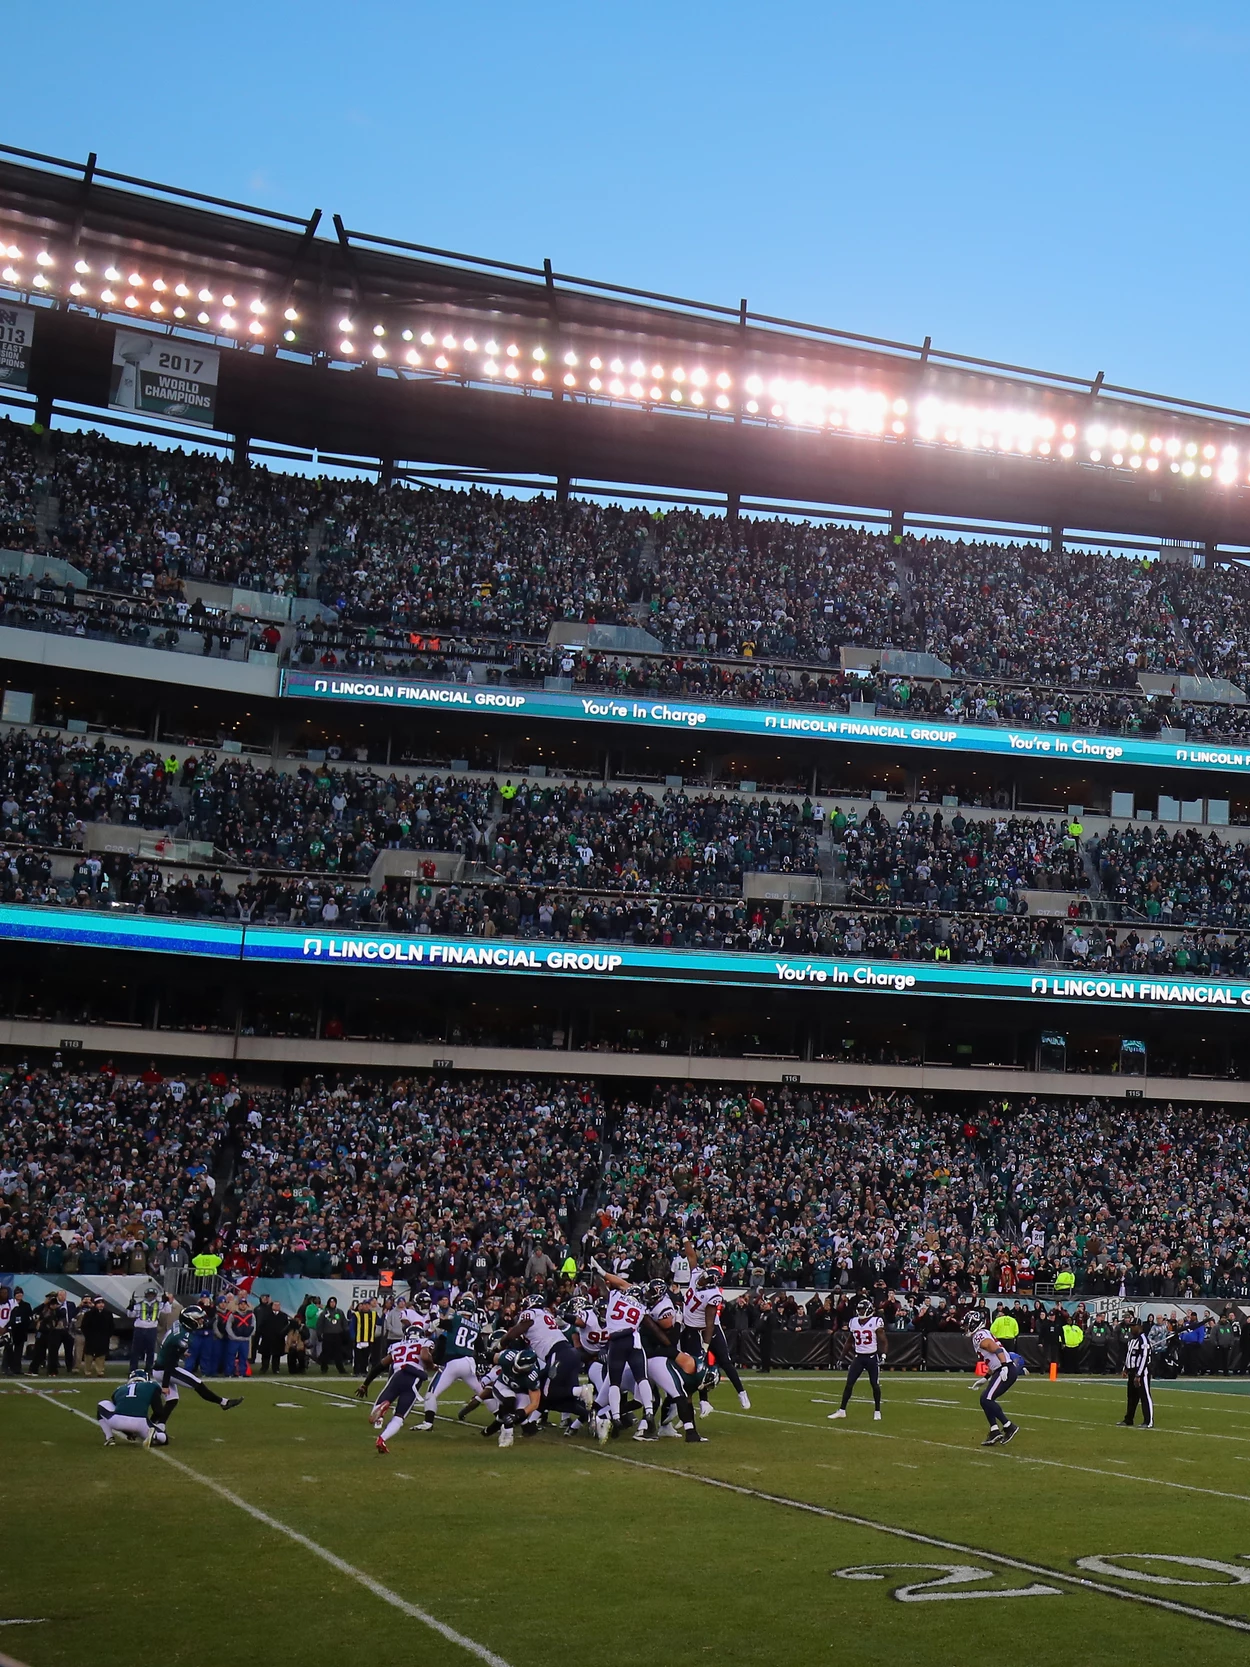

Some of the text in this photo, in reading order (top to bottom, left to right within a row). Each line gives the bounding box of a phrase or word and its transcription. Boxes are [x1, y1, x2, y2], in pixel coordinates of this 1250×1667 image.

[2, 342, 23, 353] EAST
[159, 352, 204, 375] 2017
[159, 376, 199, 395] WORLD
[144, 385, 211, 408] CHAMPIONS
[331, 681, 526, 708] LINCOLN FINANCIAL GROUP
[581, 699, 707, 726] You're In Charge
[780, 718, 957, 742] LINCOLN FINANCIAL GROUP
[1008, 734, 1123, 760] You're In Charge
[1190, 751, 1243, 765] LINCOLN
[328, 940, 622, 971] LINCOLN FINANCIAL GROUP
[775, 963, 916, 990] You're In Charge
[1053, 979, 1134, 999] LINCOLN
[1139, 984, 1237, 1004] FINANCIAL
[911, 1141, 920, 1149] 92
[986, 1218, 994, 1226] 12
[1035, 1233, 1042, 1241] 20
[387, 1242, 395, 1250] 11
[403, 1256, 412, 1264] 99
[678, 1262, 687, 1270] 12
[380, 1270, 394, 1287] 3
[352, 1286, 397, 1299] Eags
[685, 1287, 702, 1313] 97
[1241, 1288, 1248, 1296] 11
[610, 1300, 641, 1326] 59
[543, 1315, 559, 1330] 9
[897, 1320, 905, 1329] 11
[455, 1327, 478, 1351] 82
[853, 1329, 873, 1345] 33
[974, 1332, 985, 1343] 52
[393, 1343, 422, 1364] 22
[126, 1383, 137, 1398] 1
